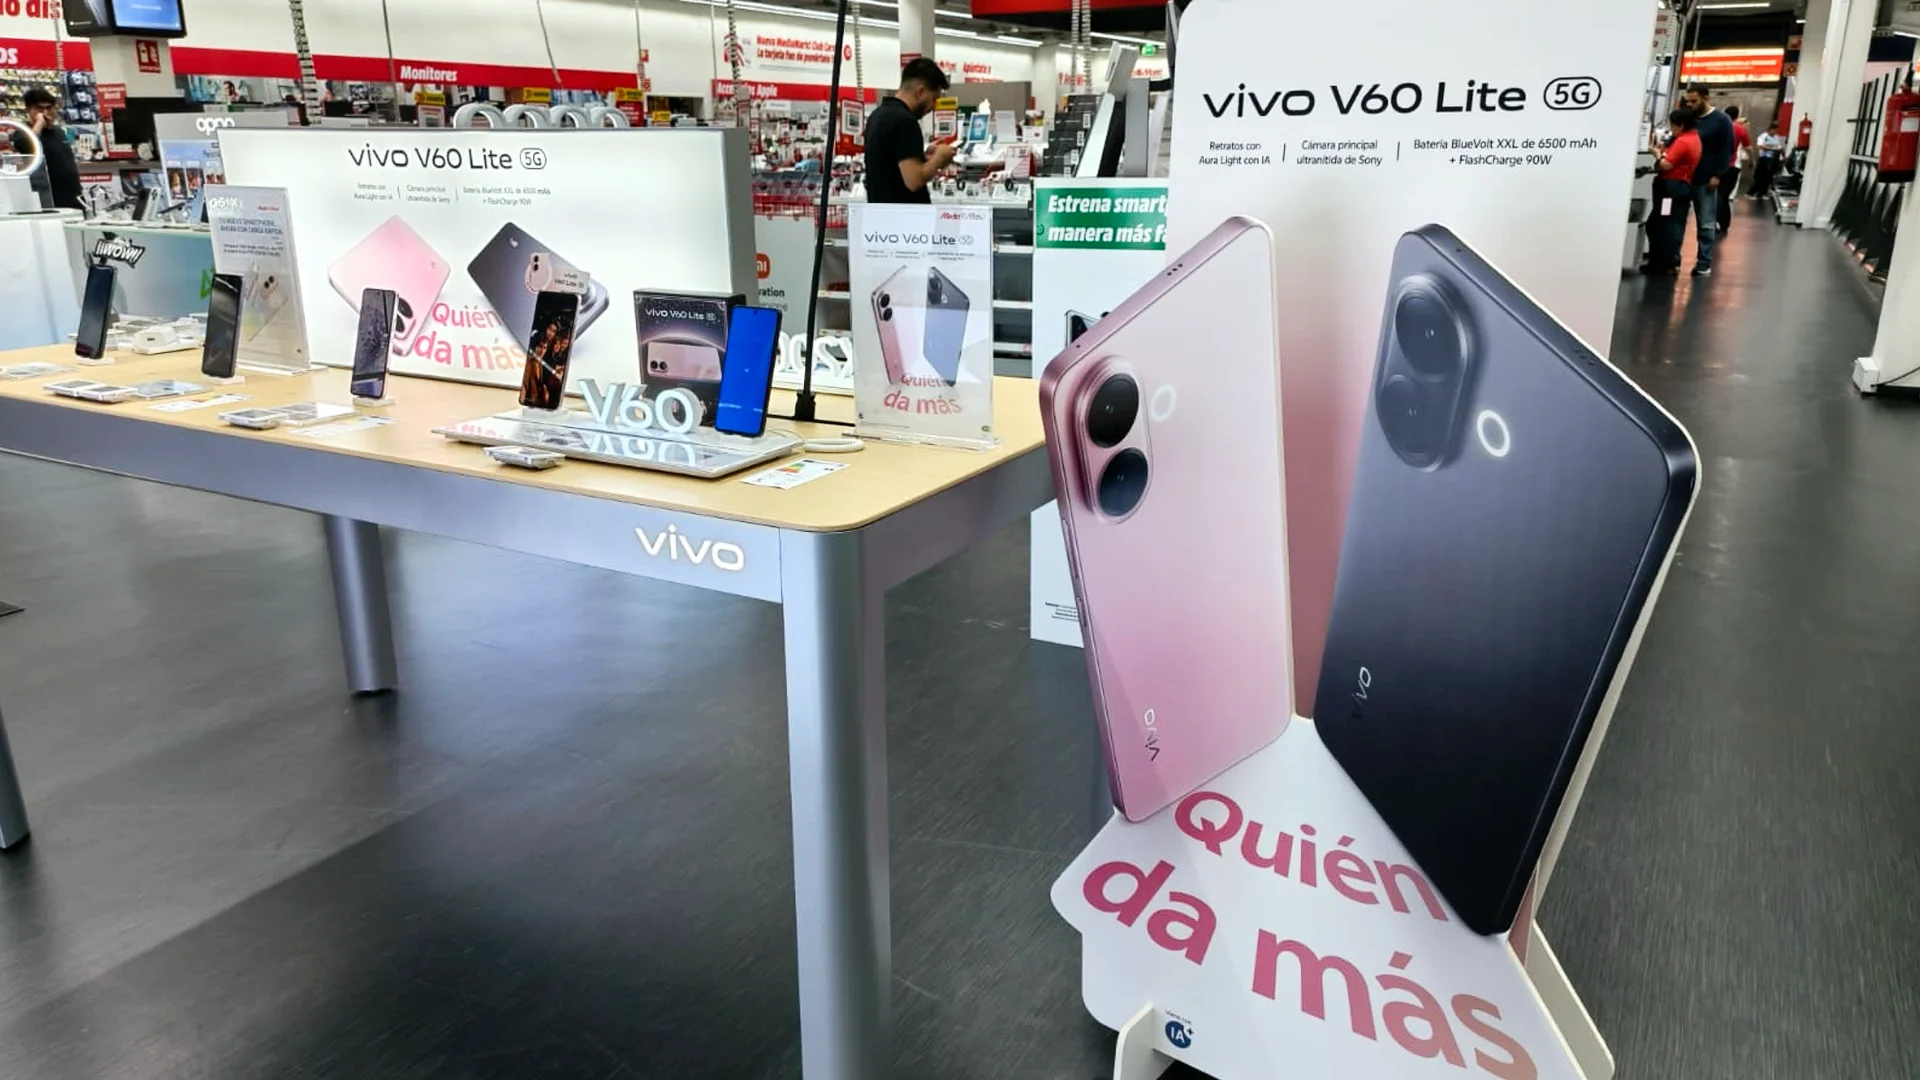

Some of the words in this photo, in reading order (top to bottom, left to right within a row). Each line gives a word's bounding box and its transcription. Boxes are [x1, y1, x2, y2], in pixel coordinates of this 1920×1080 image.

[400, 65, 458, 82] Monitores
[757, 83, 778, 98] Apple
[1203, 83, 1315, 117] vivo
[1330, 82, 1423, 114] V60
[1436, 79, 1526, 113] Lite
[1551, 80, 1595, 106] 5G
[1209, 141, 1244, 151] Retratos
[1245, 142, 1261, 151] con
[1301, 139, 1336, 150] Cámara
[1337, 139, 1378, 152] principal
[1451, 138, 1494, 149] BlueVolt
[1496, 138, 1519, 149] XXL
[1521, 138, 1536, 149] de
[1538, 138, 1567, 149] 6500
[1569, 138, 1597, 149] mAh
[348, 143, 409, 167] vivo
[414, 147, 462, 169] V60
[469, 147, 513, 170] Lite
[523, 150, 544, 167] 5G
[1199, 155, 1218, 165] Aura
[1220, 155, 1242, 167] Light
[1243, 157, 1260, 165] con
[1261, 155, 1271, 165] IA
[1344, 154, 1357, 165] de
[1358, 154, 1383, 167] Sony
[1459, 154, 1523, 168] FlashCharge
[1525, 154, 1552, 165] 90W
[1048, 195, 1111, 214] Estrena
[864, 232, 899, 243] vivo
[902, 233, 929, 244] V60
[932, 233, 956, 245] Lite
[1047, 226, 1113, 242] manera
[1115, 222, 1153, 243] más
[432, 302, 500, 329] Quién
[645, 308, 668, 318] vivo
[670, 309, 687, 319] V60
[688, 309, 705, 320] Lite
[414, 330, 451, 365] da
[462, 337, 525, 370] más
[578, 379, 702, 434] V60
[883, 390, 909, 412] da
[916, 394, 963, 415] más
[634, 524, 744, 571] vivo
[1351, 666, 1371, 712] ivo
[1144, 708, 1160, 761] vivo
[1174, 790, 1449, 922] Quién
[1082, 860, 1217, 965] da
[1252, 928, 1538, 1080] más
[1170, 1026, 1185, 1044] IA
